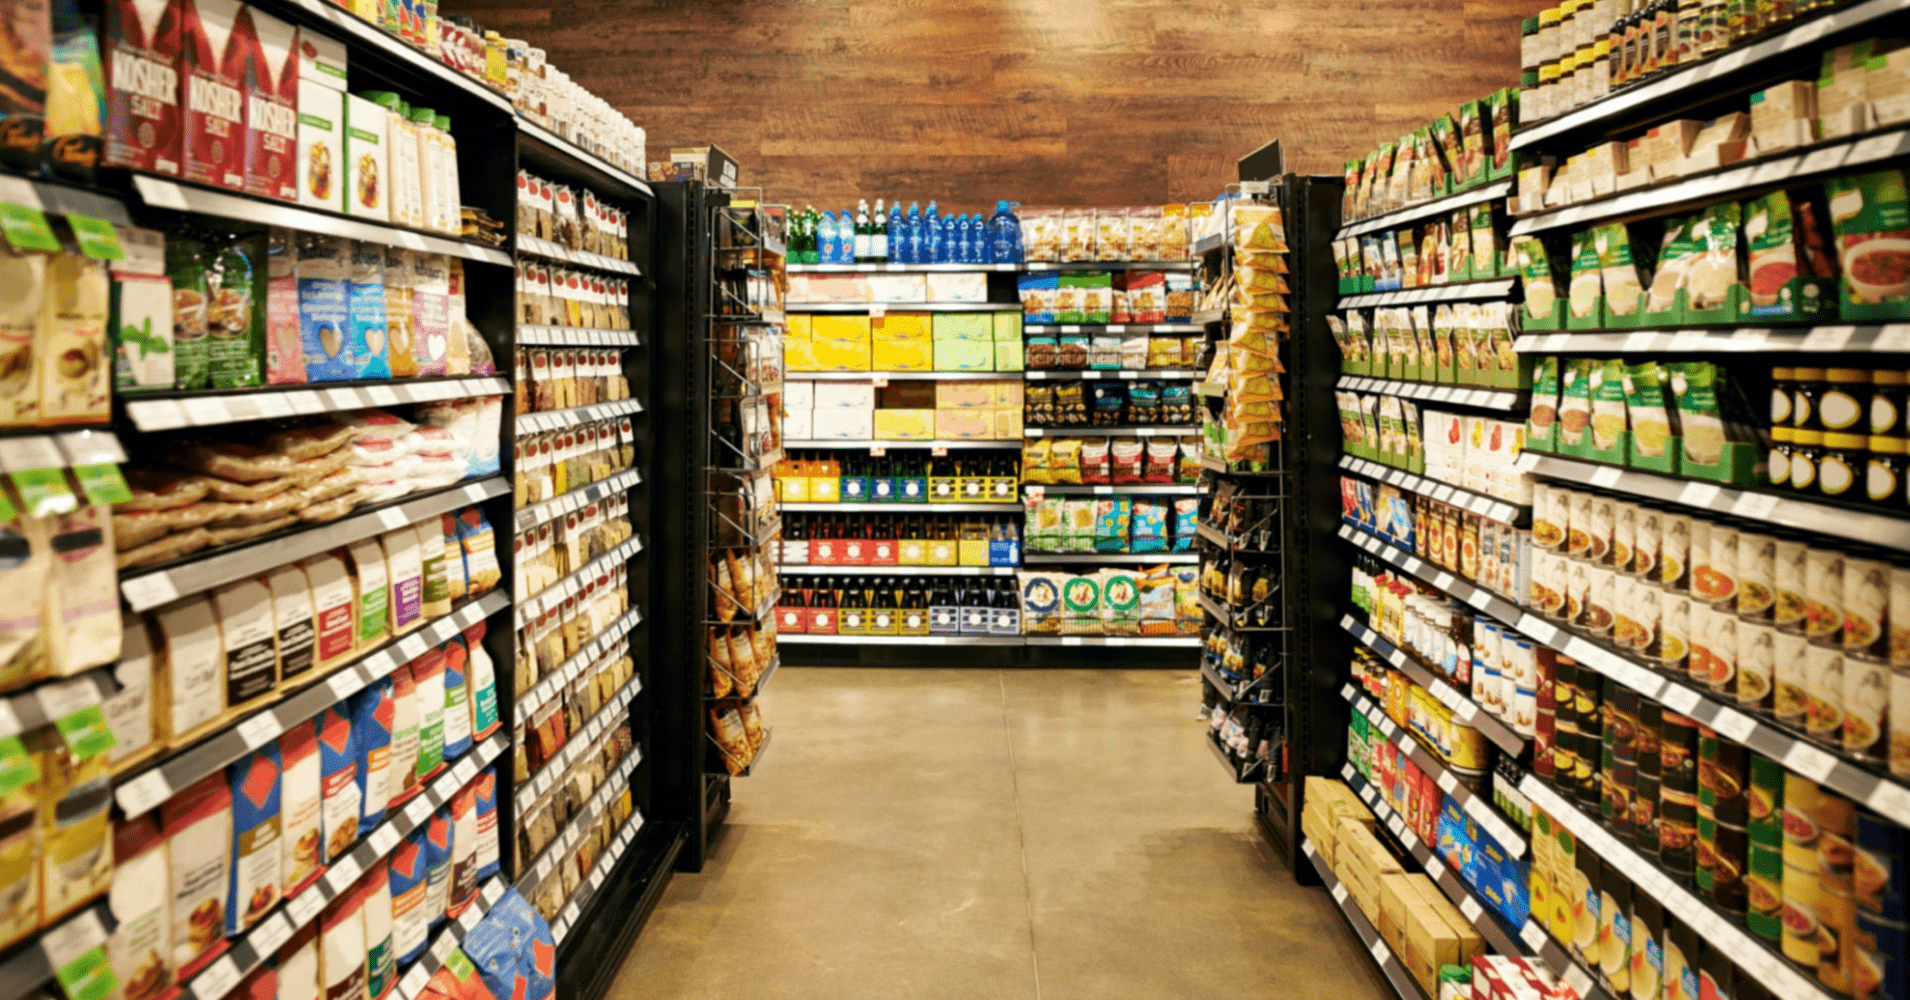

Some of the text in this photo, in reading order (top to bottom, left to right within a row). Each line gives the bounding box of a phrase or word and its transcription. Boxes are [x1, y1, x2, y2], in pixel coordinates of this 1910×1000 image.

[112, 49, 178, 106] KOSHER
[130, 94, 162, 121] SALT
[189, 74, 243, 124] KOSHER
[204, 114, 229, 138] SALT
[249, 95, 296, 140] KOSHER
[263, 132, 287, 154] SALT
